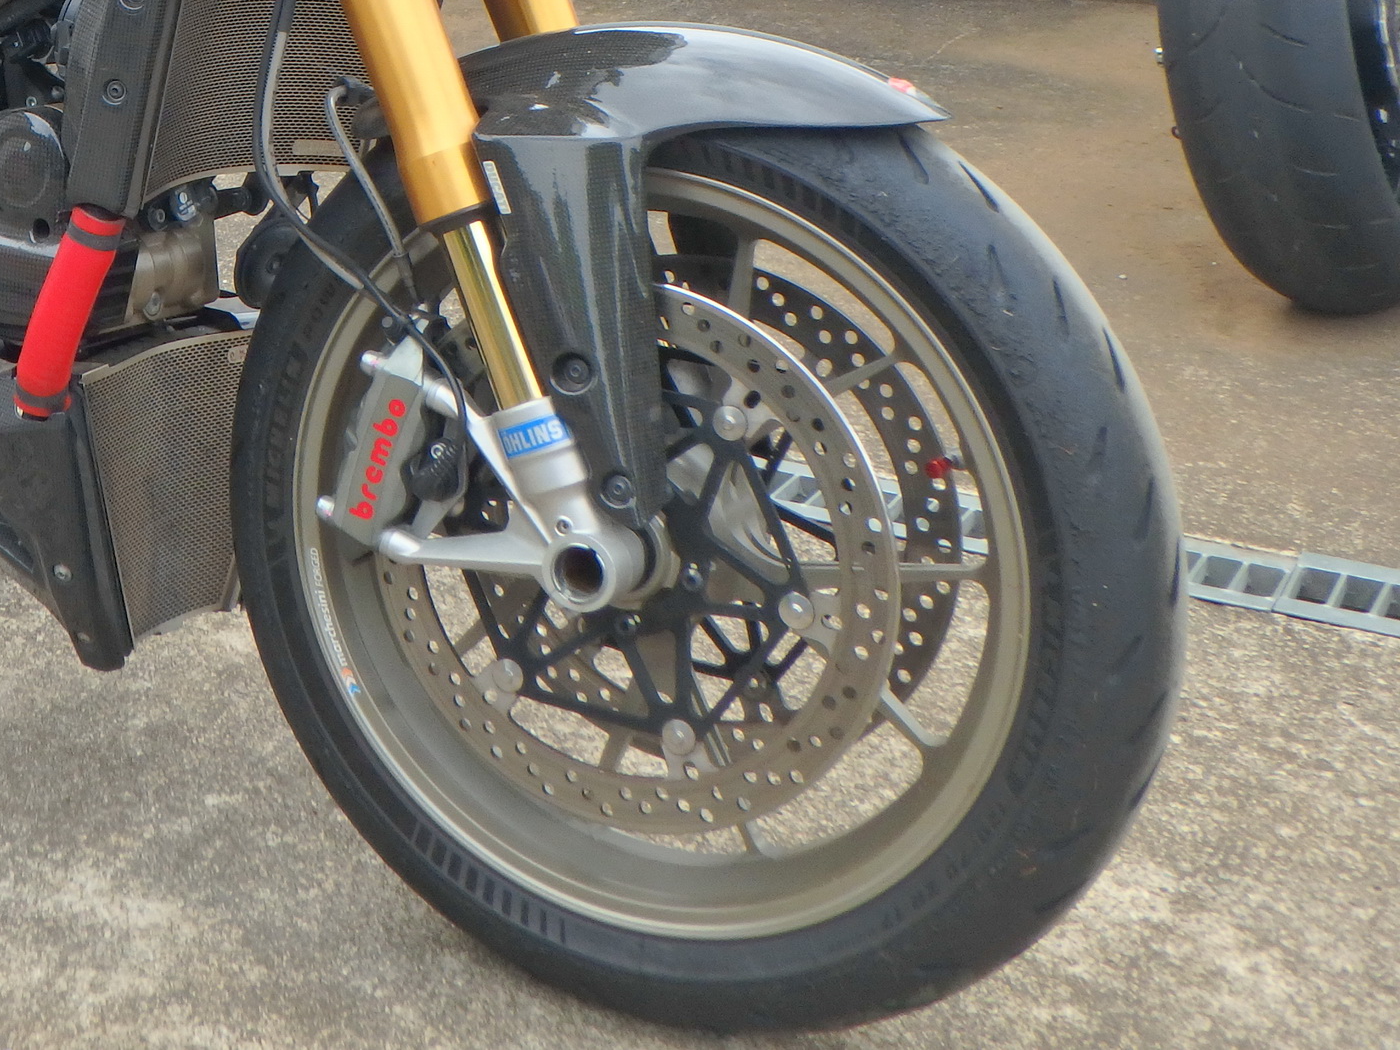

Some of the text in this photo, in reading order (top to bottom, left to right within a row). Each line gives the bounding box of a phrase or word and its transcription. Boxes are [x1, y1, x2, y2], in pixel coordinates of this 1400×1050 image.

[348, 398, 406, 520] brembo
[310, 547, 348, 667] marchesini FORGED
